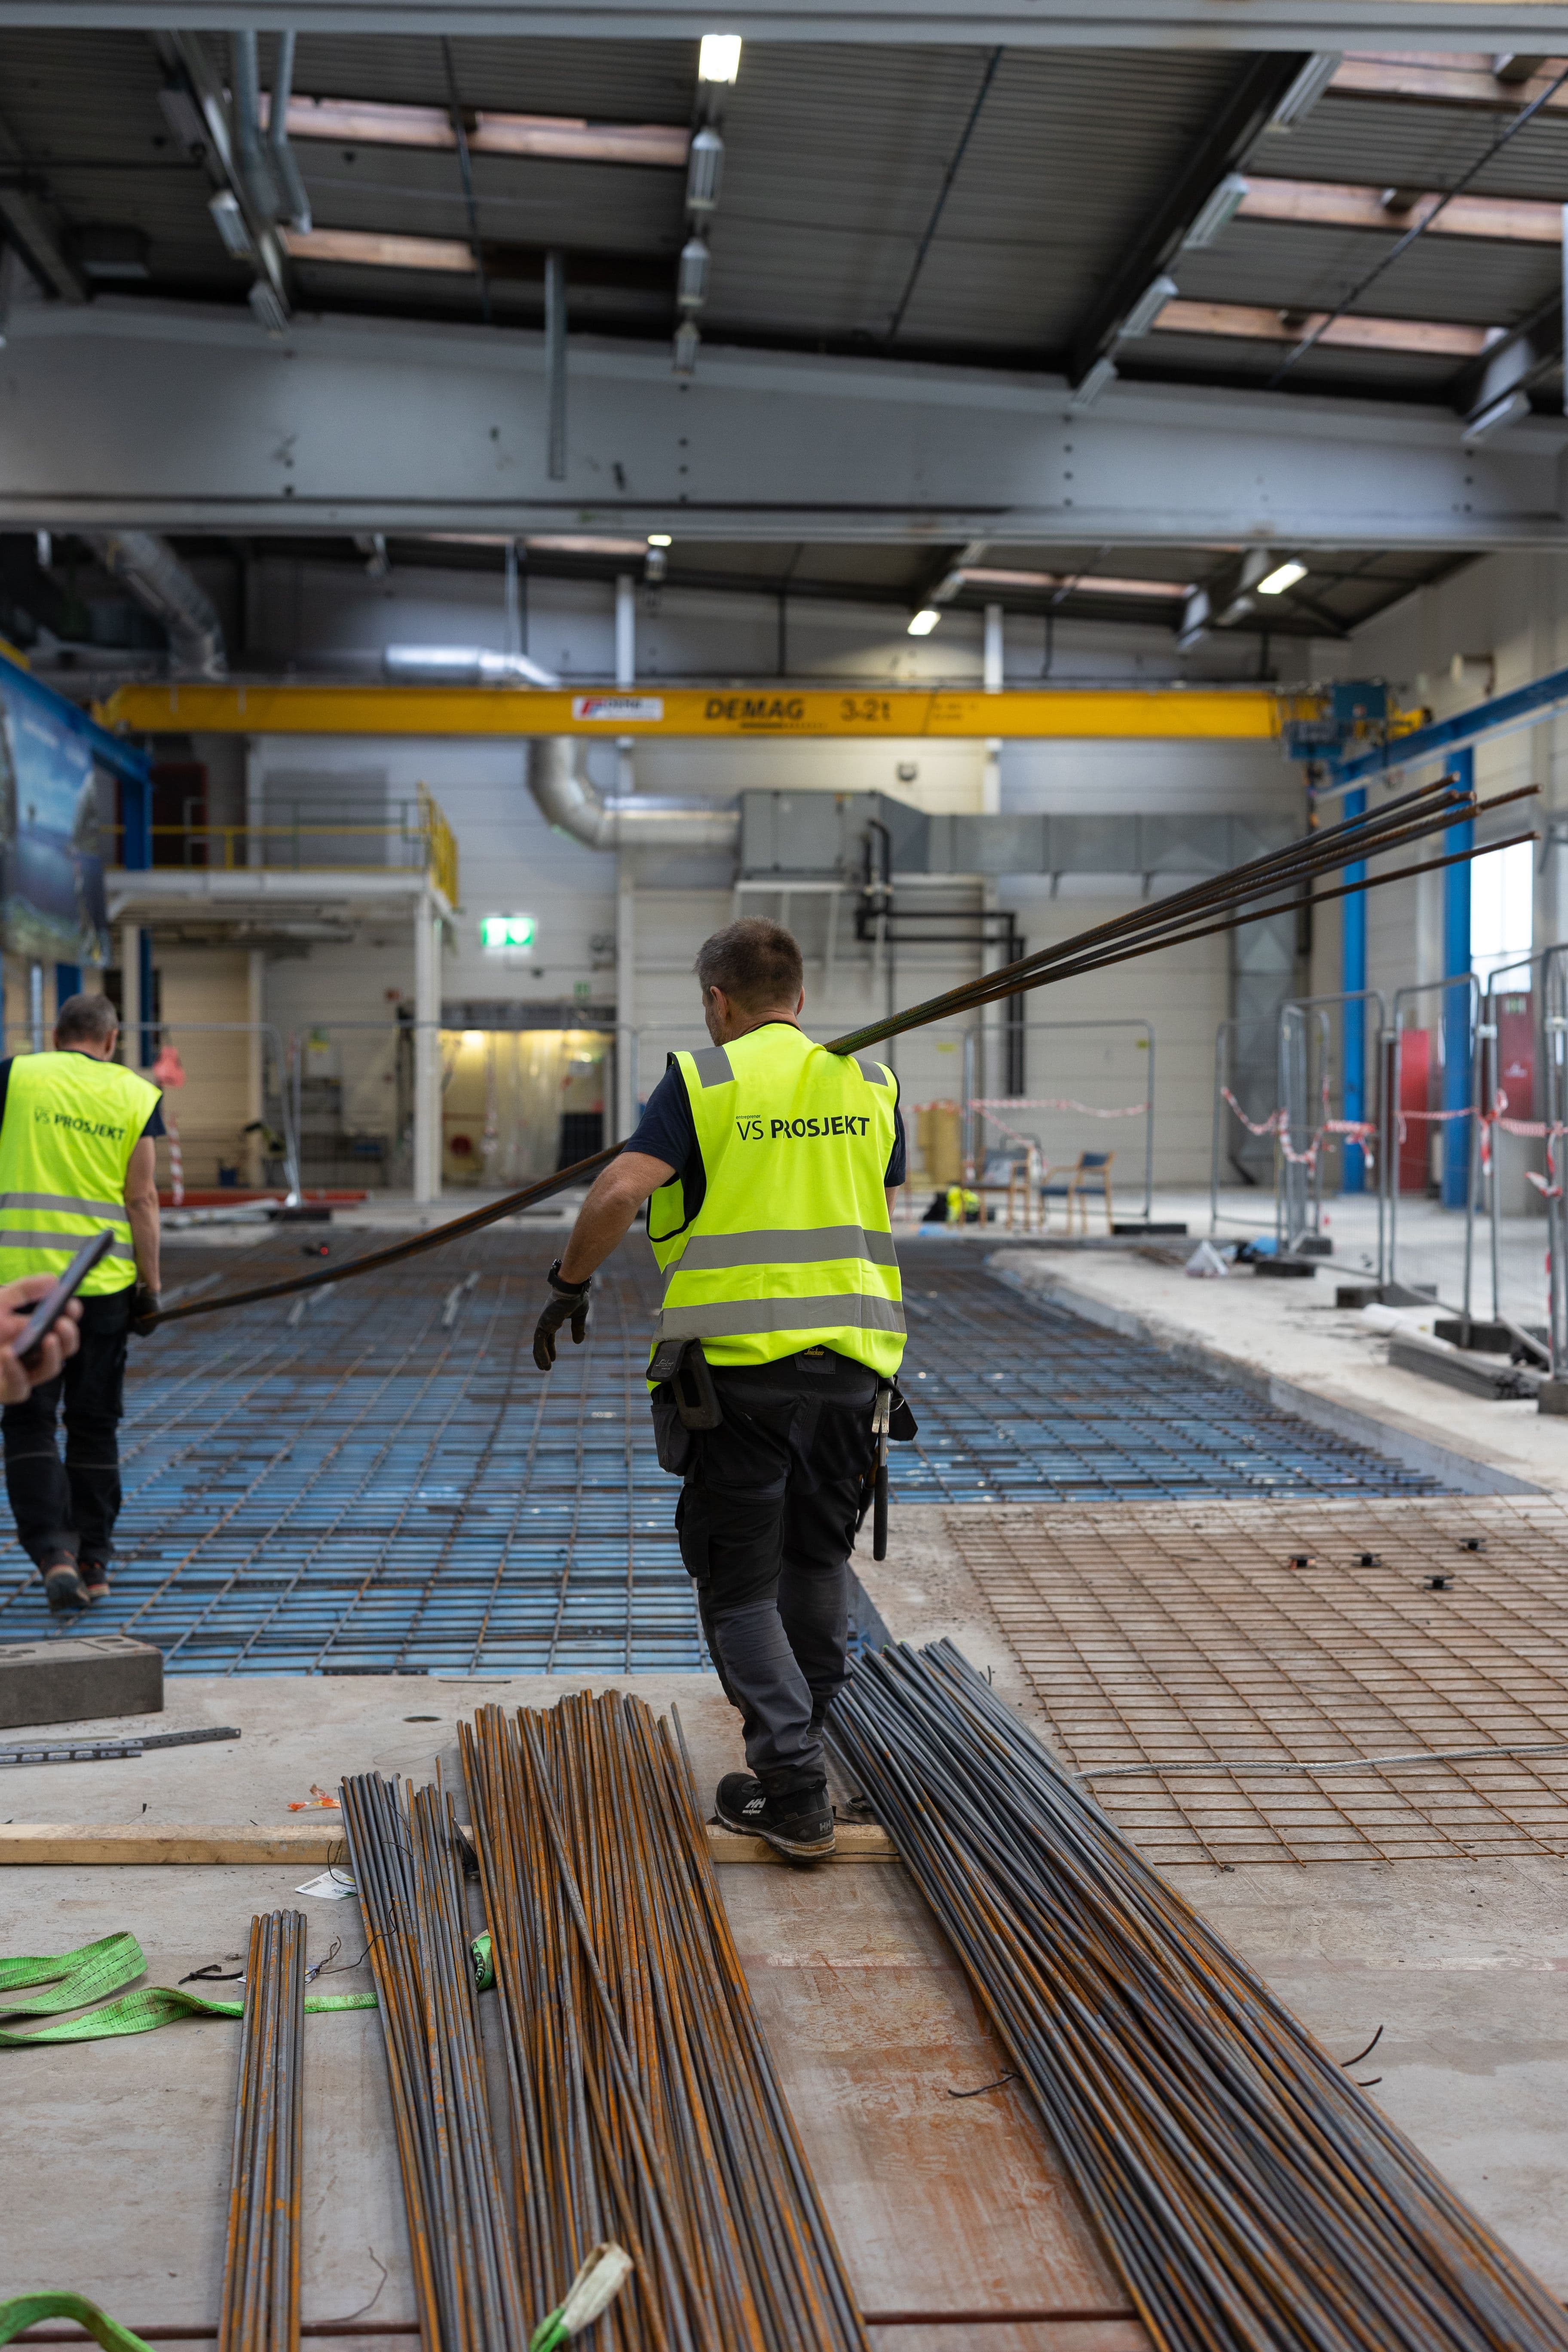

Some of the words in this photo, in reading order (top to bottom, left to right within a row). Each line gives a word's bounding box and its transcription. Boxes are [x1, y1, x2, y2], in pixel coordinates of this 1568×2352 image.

[705, 698, 804, 720] DEMAG
[54, 1114, 125, 1140] PROSJEKT
[736, 1120, 764, 1140] VS
[770, 1115, 870, 1139] PROSJEKT
[744, 1798, 766, 1808] HH
[819, 1820, 831, 1831] HH
